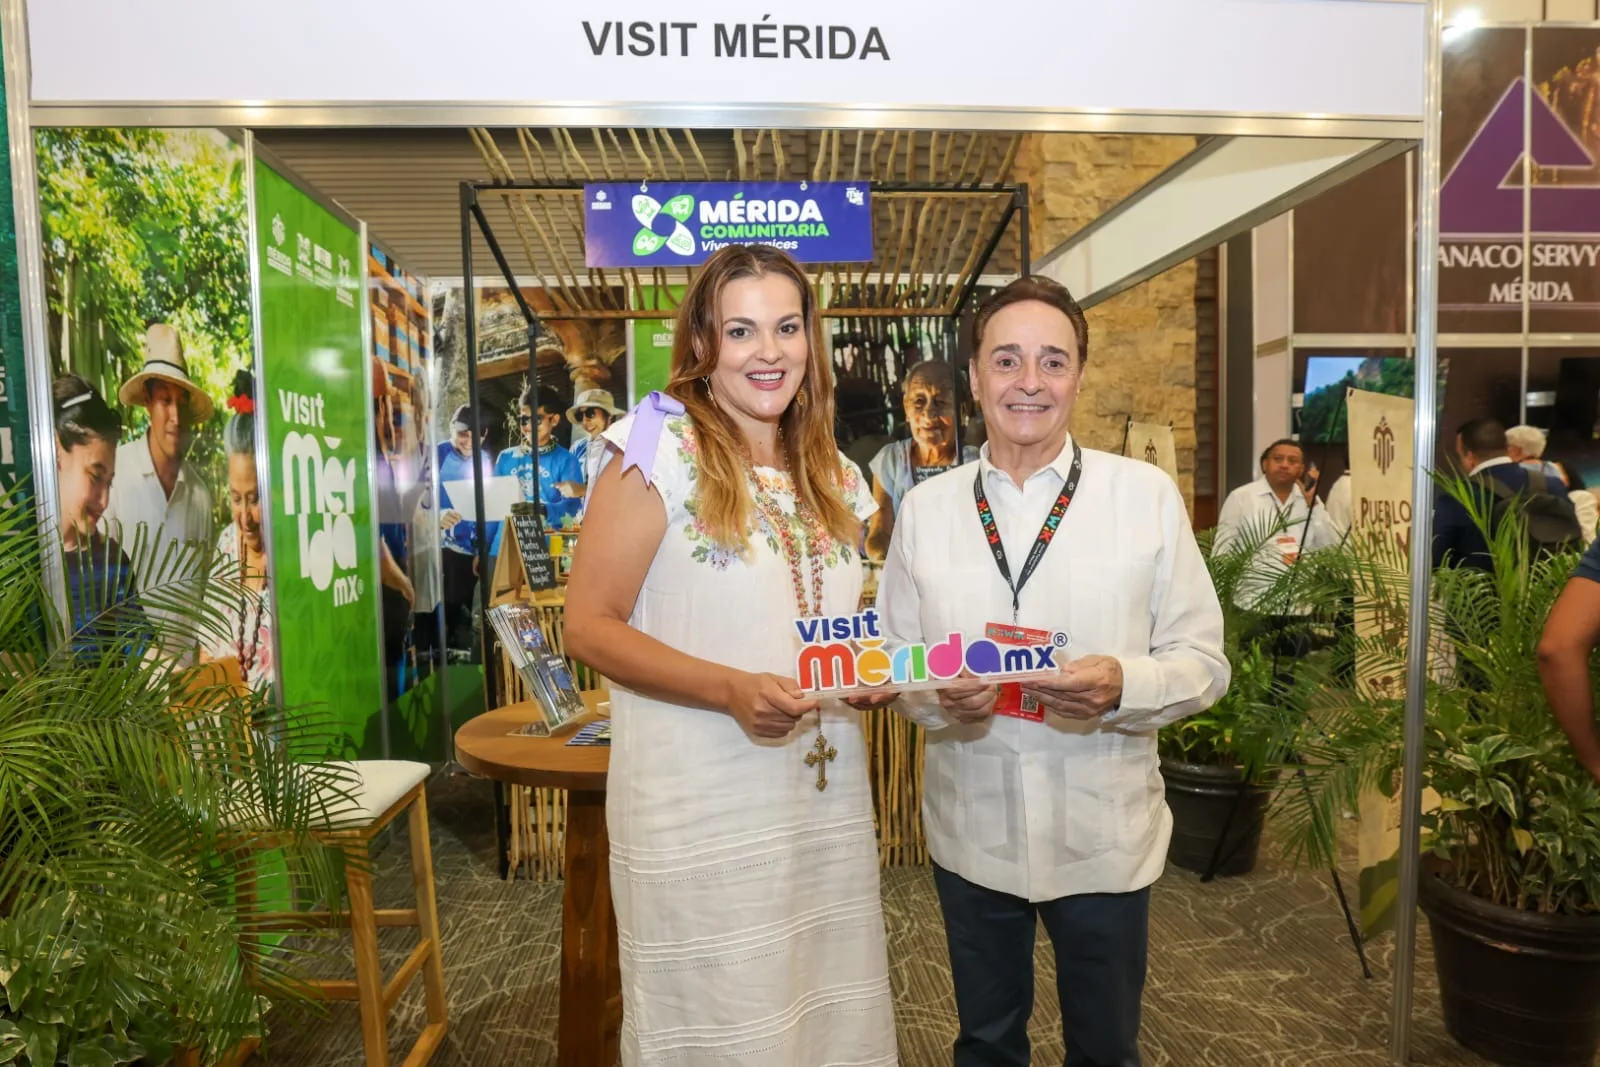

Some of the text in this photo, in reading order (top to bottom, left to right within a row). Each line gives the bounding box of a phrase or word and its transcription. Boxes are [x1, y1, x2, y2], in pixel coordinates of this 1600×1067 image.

[582, 14, 892, 61] VISIT MÉRIDA
[700, 192, 824, 224] MÉRIDA
[700, 223, 830, 239] COMUNITARIA
[1488, 276, 1575, 303] MÉRIDA
[1360, 496, 1412, 529] PUEBLO
